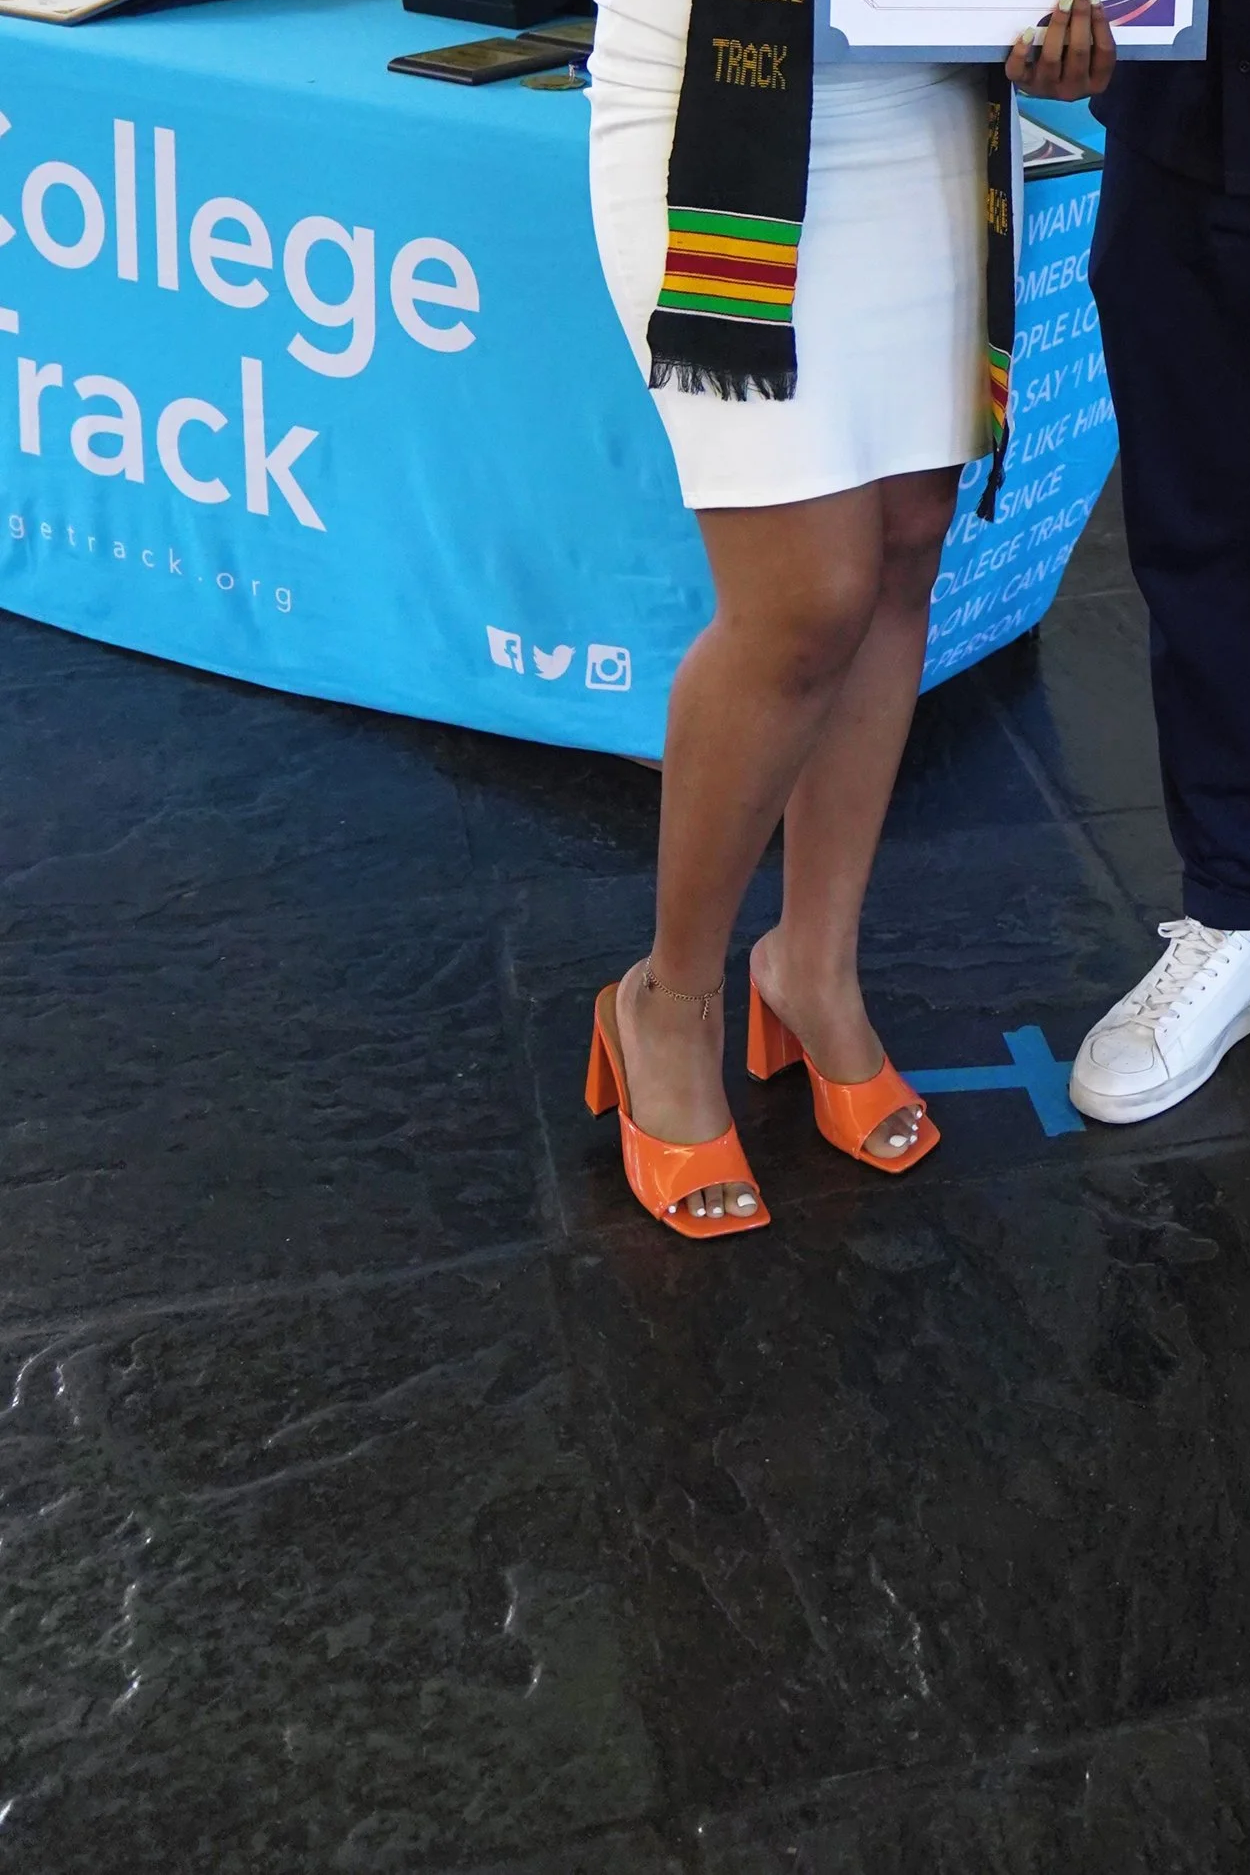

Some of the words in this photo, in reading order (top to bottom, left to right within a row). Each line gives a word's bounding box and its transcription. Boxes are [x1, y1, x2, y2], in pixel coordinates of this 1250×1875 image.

[712, 38, 788, 90] TRACK
[0, 111, 480, 378] ollege
[1028, 190, 1101, 246] WANT
[0, 306, 327, 532] rack
[1021, 413, 1072, 464] LIKE
[994, 464, 1066, 525] SINCE
